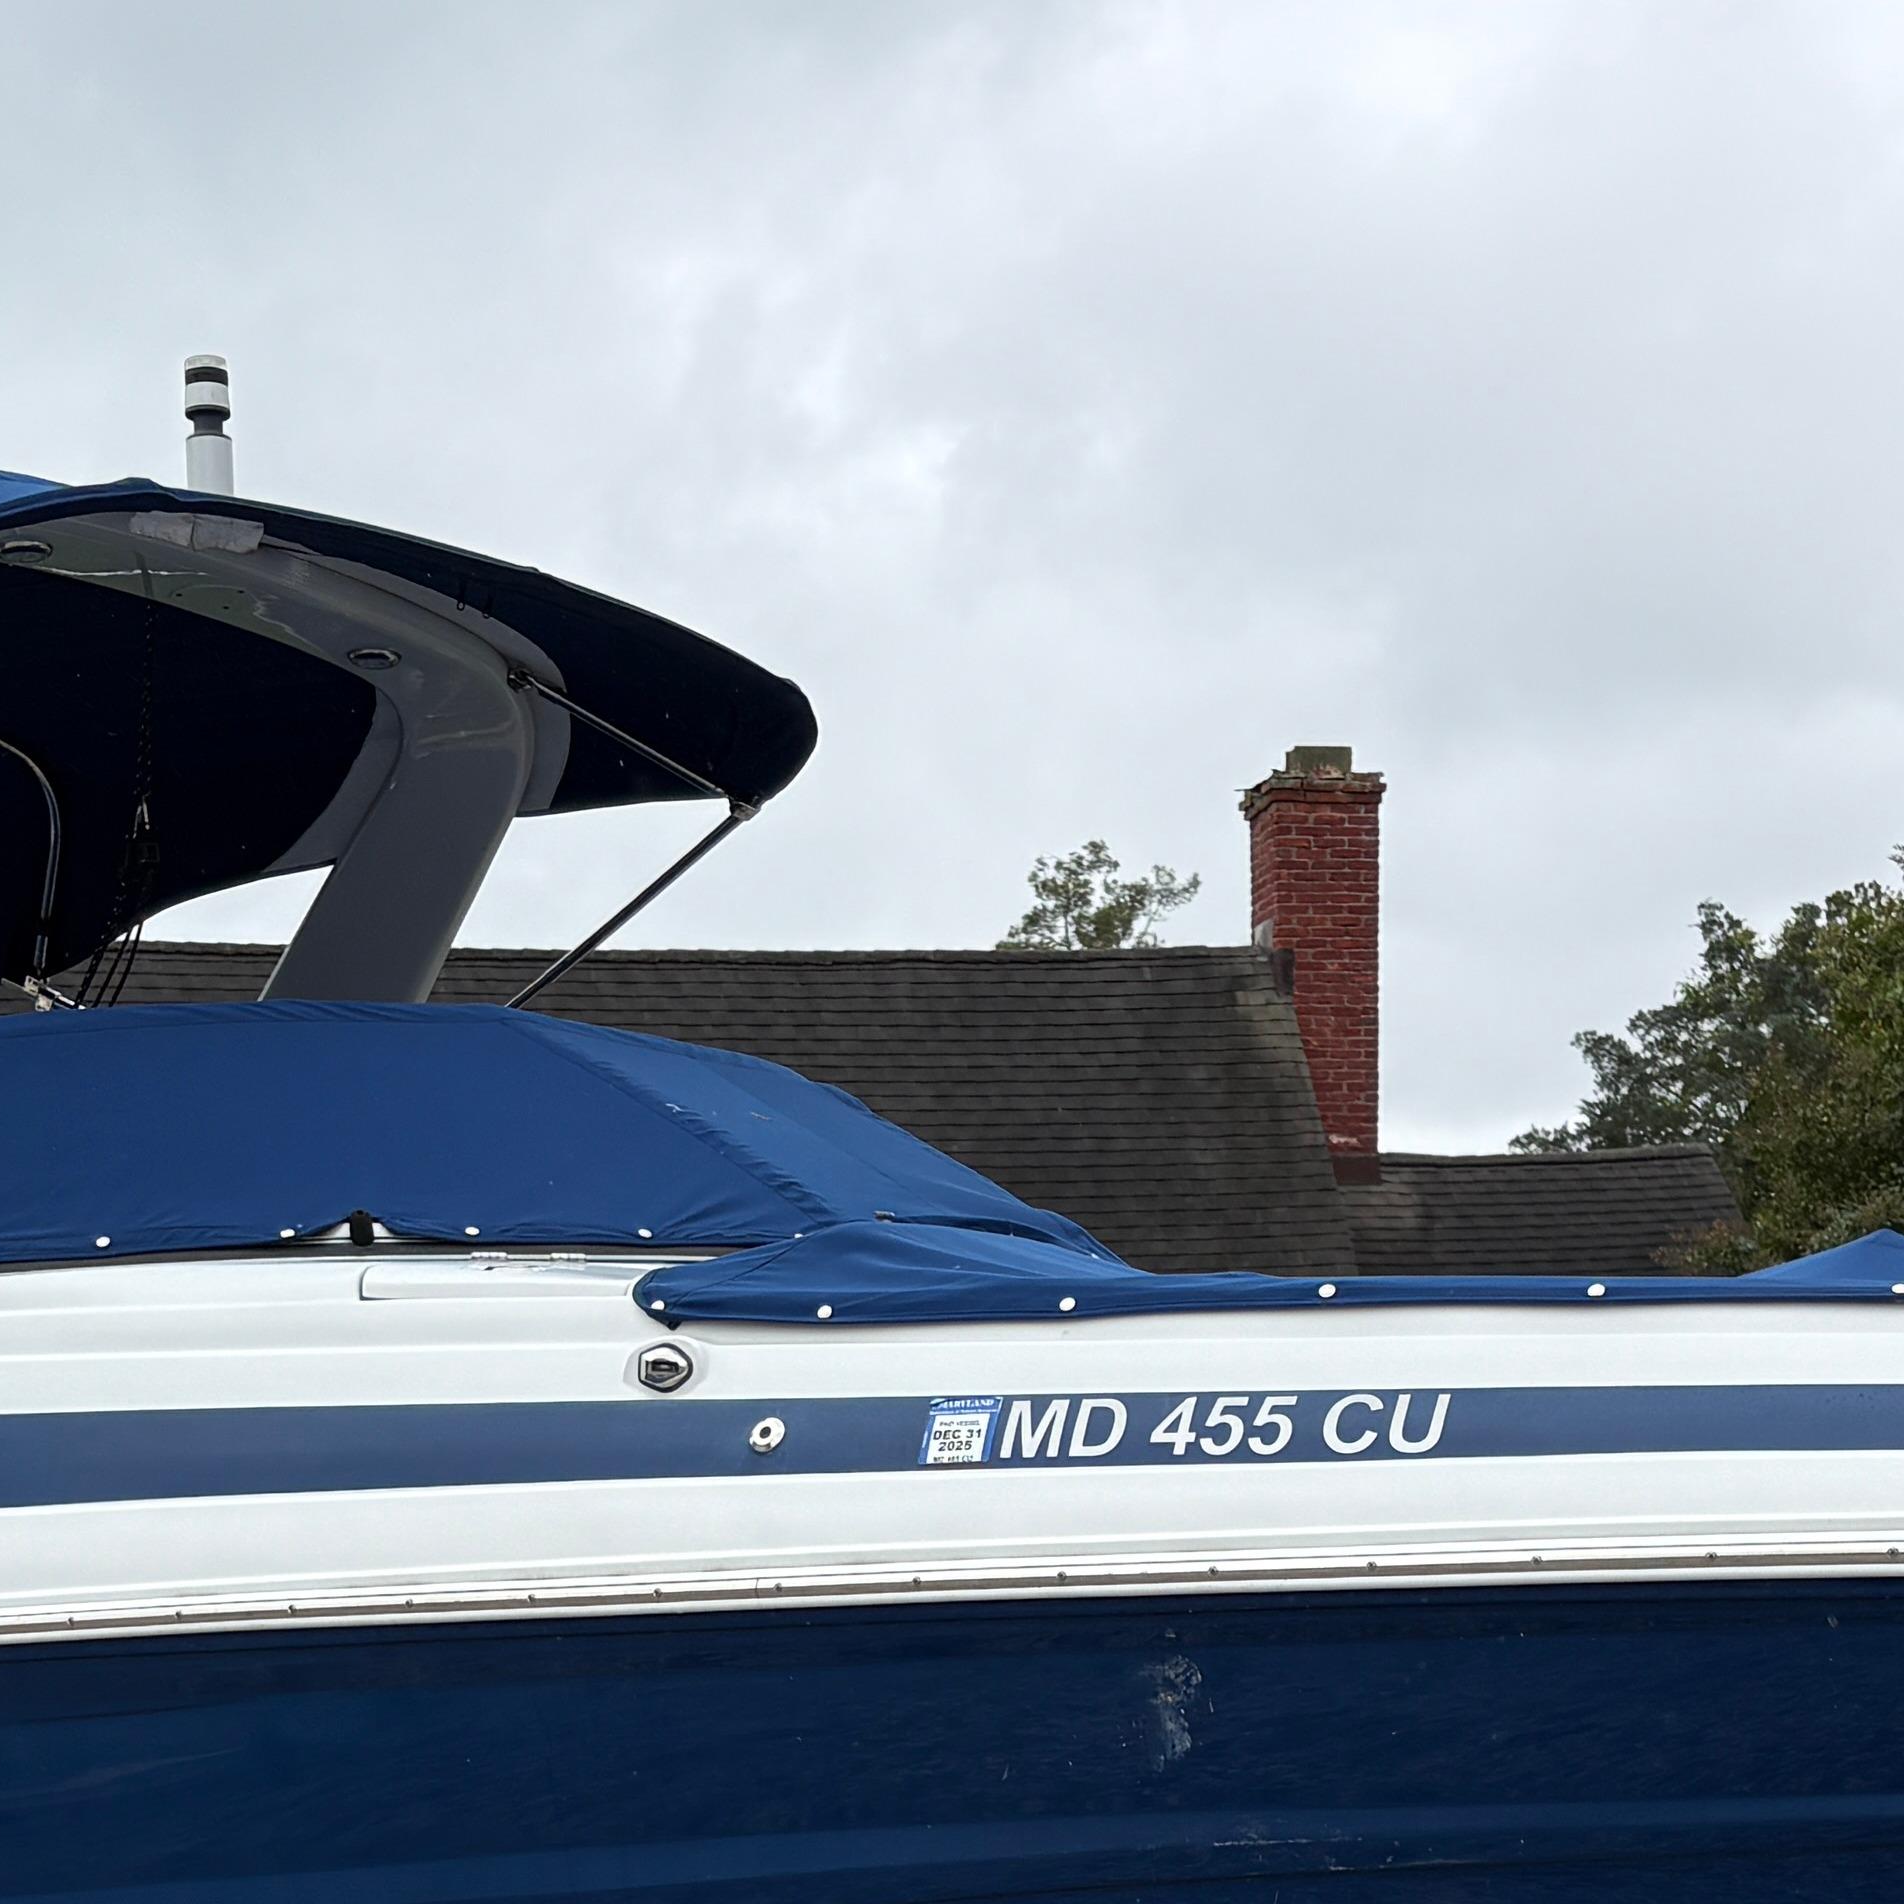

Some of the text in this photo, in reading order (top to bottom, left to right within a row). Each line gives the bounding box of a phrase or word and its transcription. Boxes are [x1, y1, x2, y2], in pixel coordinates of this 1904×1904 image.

[999, 1393, 1452, 1460] MD 455 CU
[933, 1428, 982, 1441] DEC 31
[938, 1440, 973, 1452] 2025
